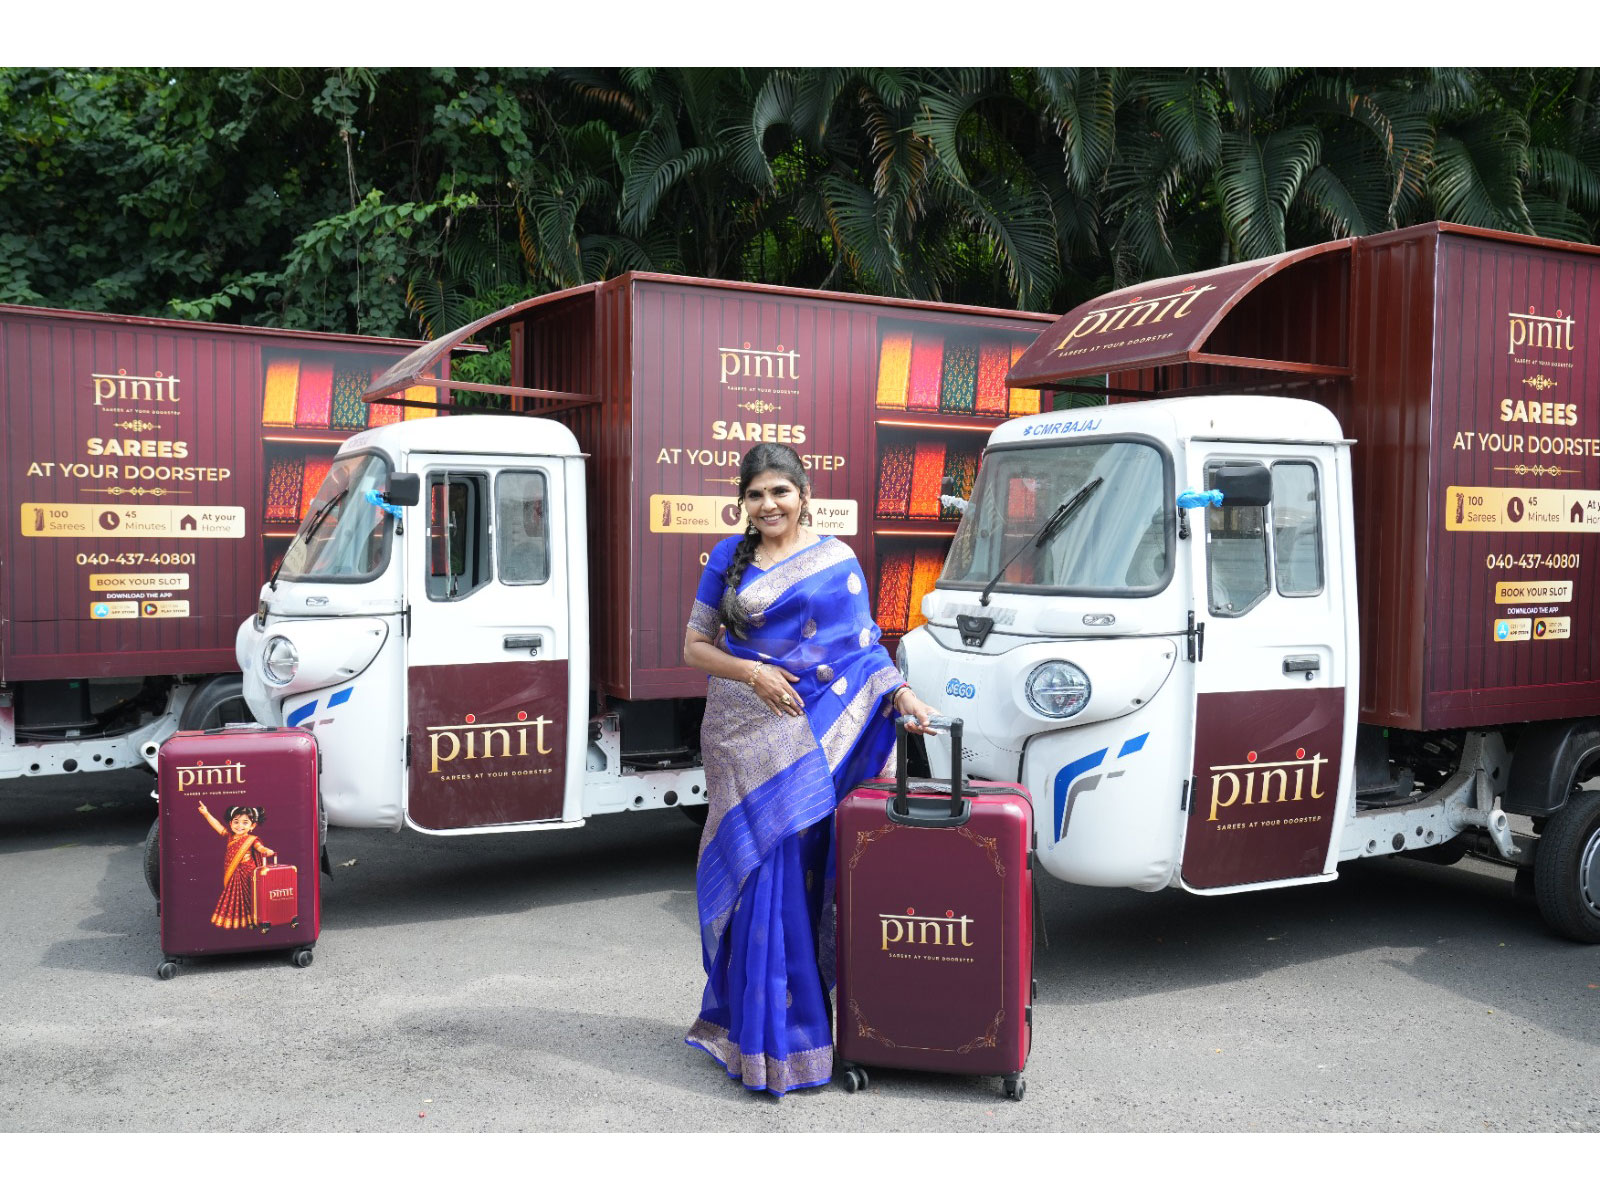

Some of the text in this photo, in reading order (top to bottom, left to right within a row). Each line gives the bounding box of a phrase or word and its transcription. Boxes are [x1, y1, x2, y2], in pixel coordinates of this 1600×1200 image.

[1054, 284, 1217, 351] pinit
[1508, 305, 1576, 354] pinit
[1103, 340, 1125, 349] YOUR
[1127, 332, 1173, 346] DOORSTEP
[717, 342, 800, 383] pinit
[91, 369, 180, 405] pinit
[1500, 398, 1578, 426] SAREES
[711, 420, 807, 444] SAREES
[87, 437, 189, 458] SAREES
[1452, 431, 1475, 451] AT
[1478, 432, 1524, 453] YOUR
[656, 448, 682, 465] AT
[686, 448, 741, 467] YOUR
[26, 462, 231, 482] AT YOUR DOORSTEP
[676, 502, 694, 512] 100
[1468, 496, 1484, 506] 100
[1528, 496, 1538, 506] 45
[49, 510, 69, 519] 100
[125, 510, 137, 519] 45
[201, 512, 237, 524] At your
[816, 507, 849, 518] At your
[1467, 511, 1497, 523] Sarees
[1528, 511, 1560, 523] Minutes
[49, 521, 86, 531] Sarees
[125, 521, 167, 531] Minutes
[201, 523, 232, 533] Home
[676, 516, 710, 527] Sarees
[816, 520, 845, 529] Home
[76, 553, 196, 566] 040-437-40801
[1486, 553, 1580, 569] 040-437-40801
[128, 578, 156, 586] YOUR
[1500, 586, 1568, 597] BOOK YOUR SLOT
[1507, 607, 1538, 615] DOWNLOAD
[426, 710, 553, 774] pinit
[176, 759, 246, 792] pinit
[440, 773, 472, 782] SAREES
[511, 768, 553, 776] DOORSTEP
[1206, 747, 1329, 822] pinit
[1216, 822, 1246, 831] SAREES
[1261, 819, 1281, 827] YOUR
[1283, 815, 1322, 825] DOORSTEP
[879, 906, 975, 951] pinit
